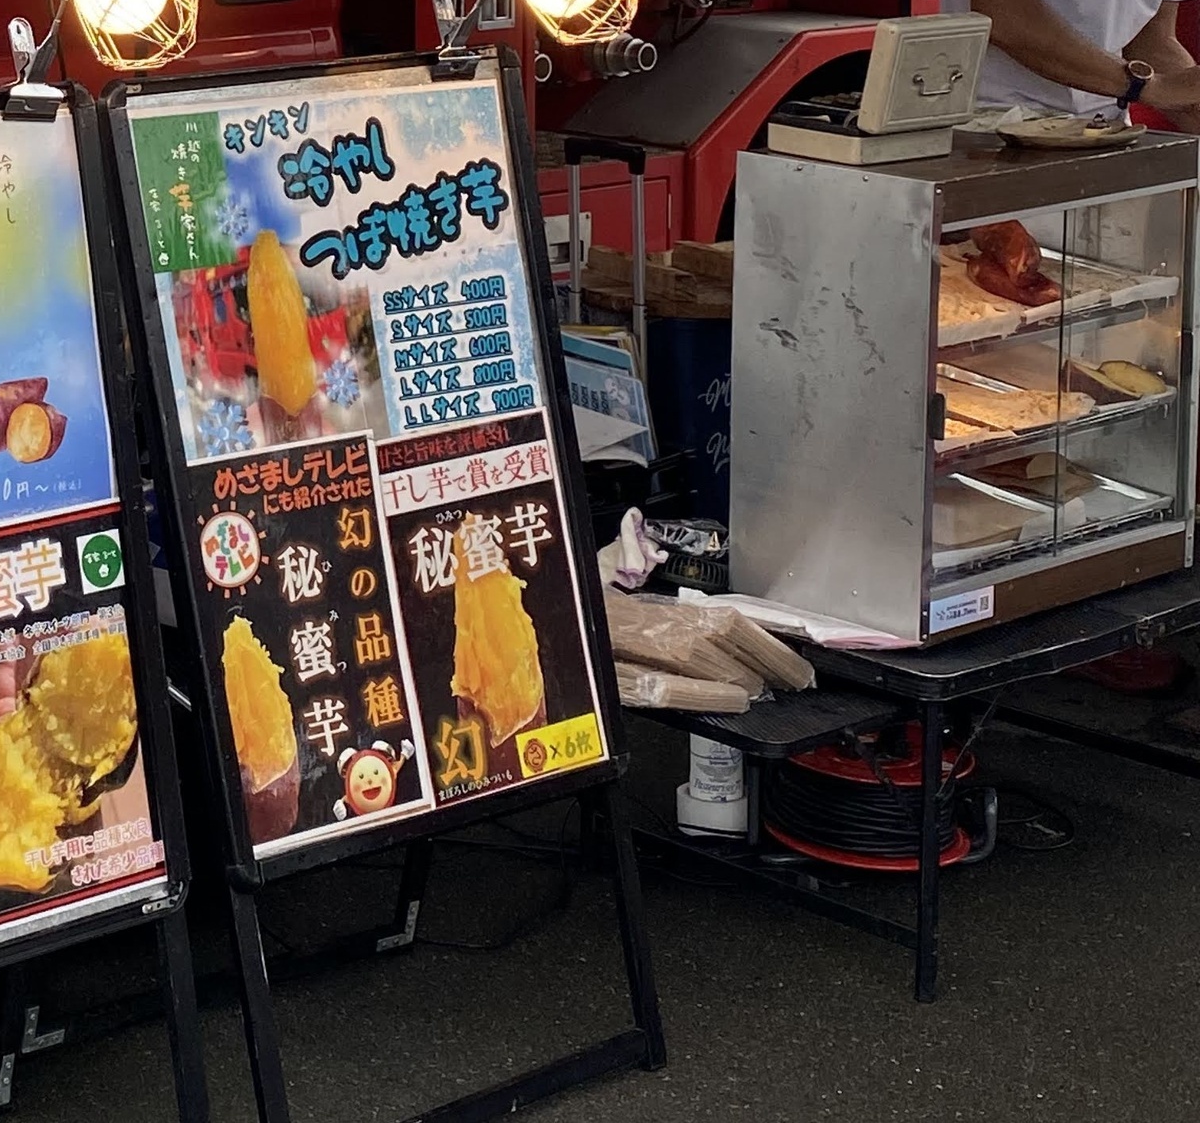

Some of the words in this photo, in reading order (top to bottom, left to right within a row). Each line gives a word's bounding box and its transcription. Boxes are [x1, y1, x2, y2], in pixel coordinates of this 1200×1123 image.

[224, 101, 309, 153] キンキン
[278, 116, 395, 207] 冷やし
[300, 158, 509, 280] つぼ焼き芋
[383, 281, 448, 310] SSサイズ
[461, 275, 505, 300] 400円
[391, 309, 452, 339] Sサイズ
[464, 303, 506, 329] 500円
[395, 337, 457, 368] Mサイズ
[469, 331, 511, 356] 600円
[400, 366, 461, 396] Lサイズ
[473, 358, 515, 384] 800円
[405, 392, 480, 425] LLサイズ
[492, 384, 534, 412] 900円
[214, 443, 368, 500] めざましテレビ
[263, 477, 372, 515] にも紹介された
[384, 445, 550, 510] 干し芋で賞を受賞
[408, 503, 553, 593] 秘蜜芋
[337, 507, 404, 728] 幻の品種
[277, 545, 349, 757] 秘蜜芋
[436, 721, 481, 786] 幻
[25, 818, 152, 871] 干し芋用に品種改良
[71, 840, 165, 886] された希少品種
